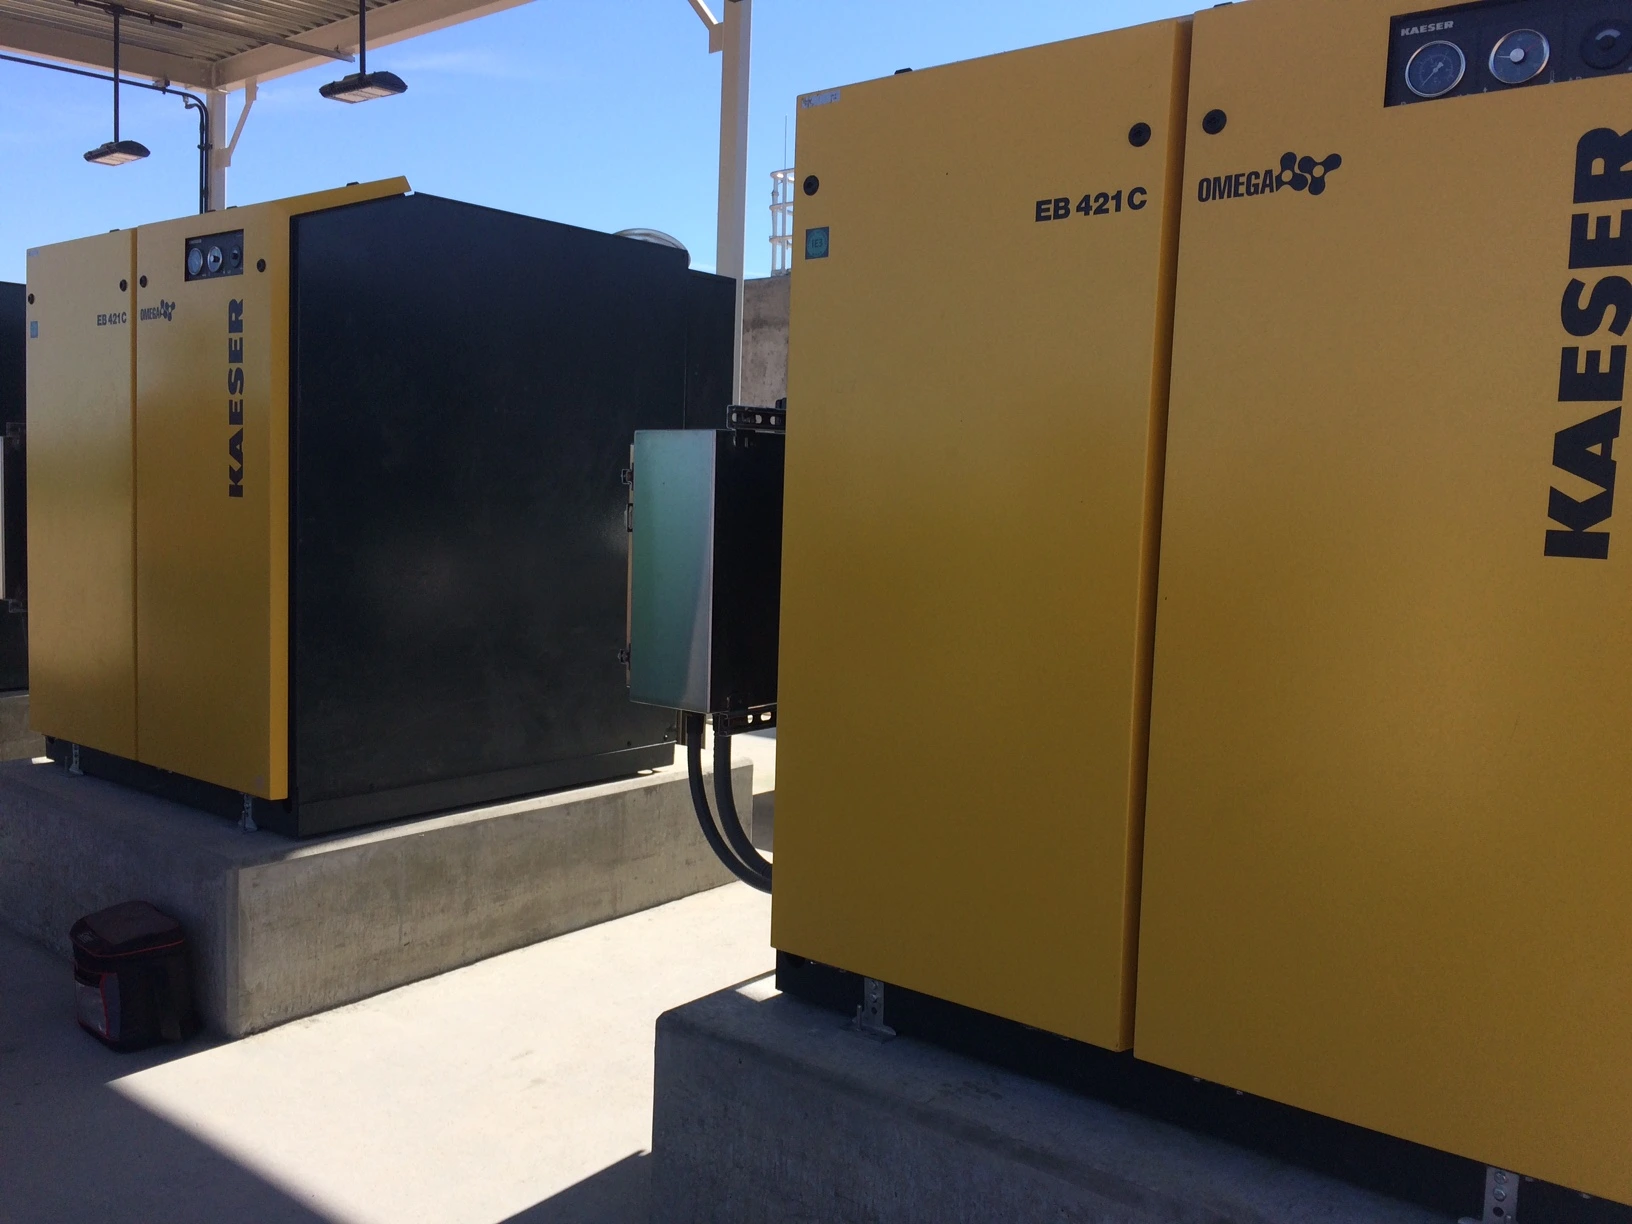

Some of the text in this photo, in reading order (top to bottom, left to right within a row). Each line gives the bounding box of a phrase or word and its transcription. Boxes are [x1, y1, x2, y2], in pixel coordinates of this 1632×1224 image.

[1400, 20, 1454, 37] KAESER
[1197, 168, 1277, 203] OMEGA
[1035, 197, 1071, 223] EB
[97, 314, 107, 326] EB
[140, 306, 160, 321] OMEGA
[1543, 126, 1632, 560] KAESER
[228, 298, 244, 498] KAESER
